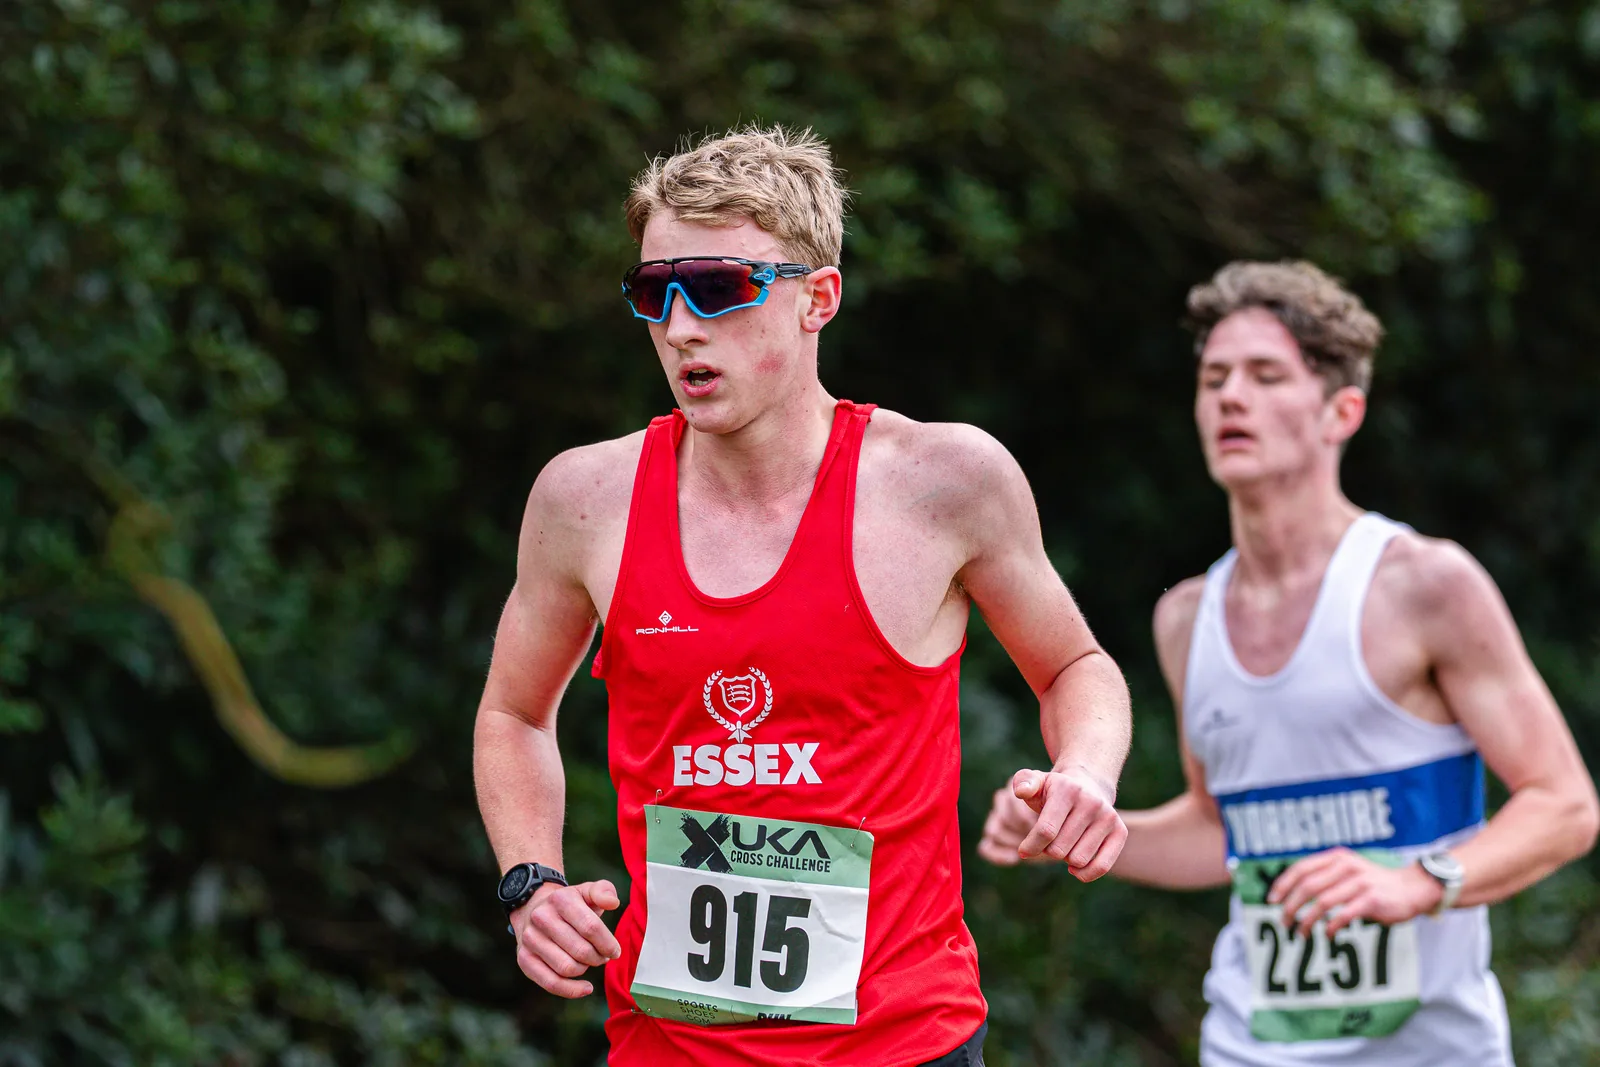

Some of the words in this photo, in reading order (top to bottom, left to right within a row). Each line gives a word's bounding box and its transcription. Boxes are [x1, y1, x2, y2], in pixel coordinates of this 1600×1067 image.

[635, 625, 699, 635] RONHILL
[672, 742, 823, 787] ESSEX
[731, 821, 831, 860] UKA
[730, 850, 764, 866] CROSS
[766, 854, 832, 873] CHALLENGE
[687, 884, 812, 994] 915
[1257, 916, 1391, 993] 2257
[677, 998, 719, 1013] SPORTS
[680, 1006, 716, 1020] SHOES
